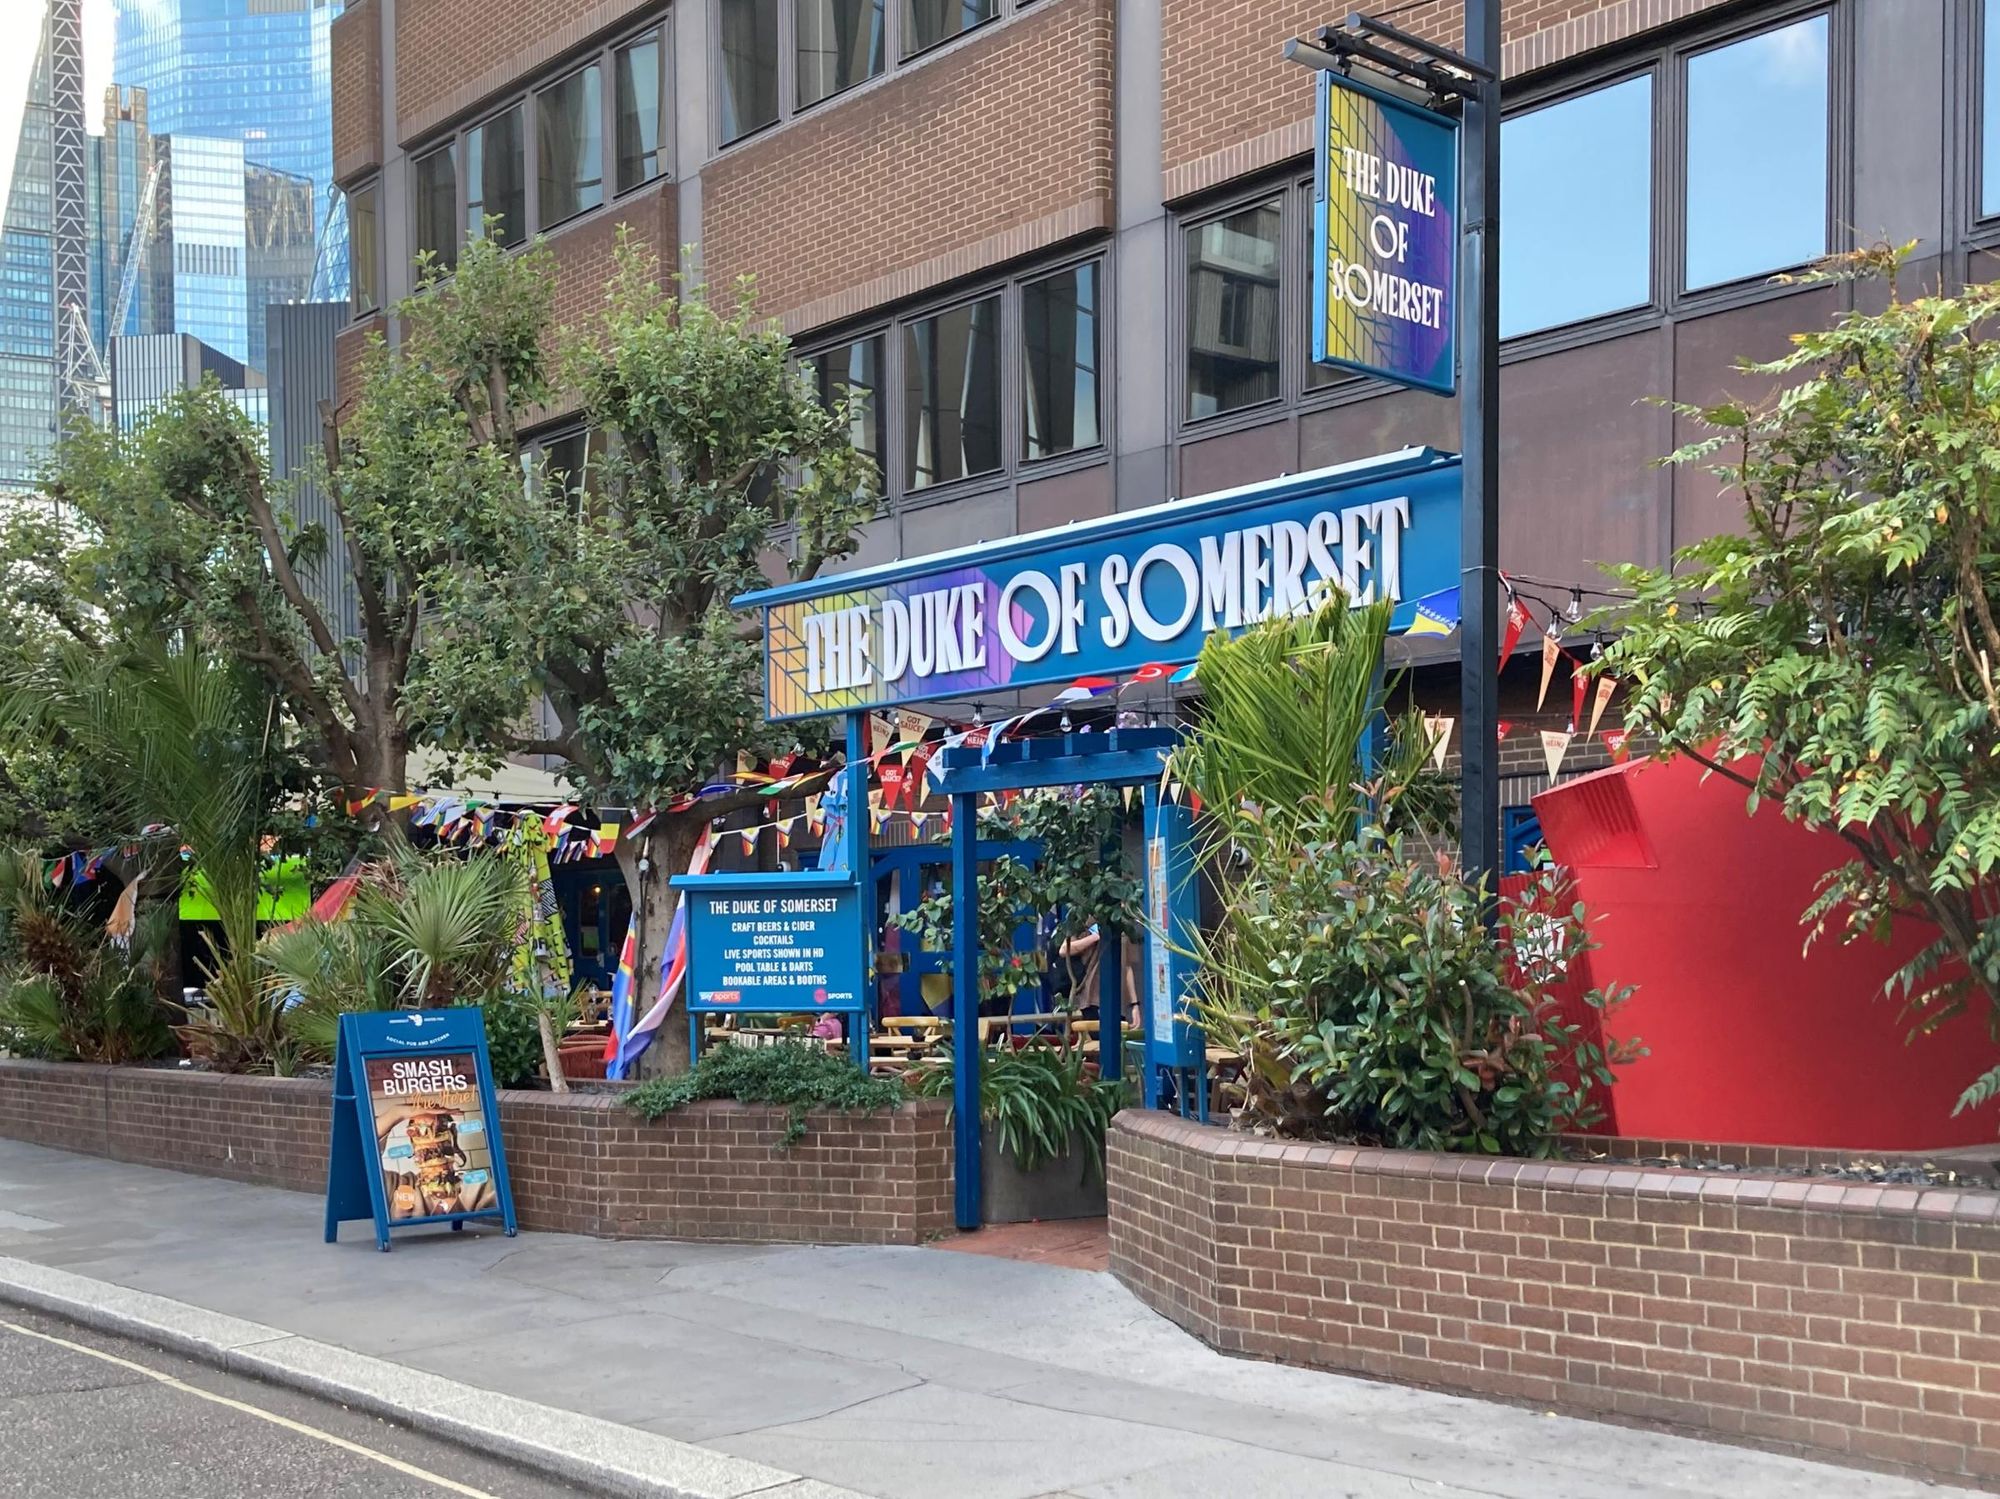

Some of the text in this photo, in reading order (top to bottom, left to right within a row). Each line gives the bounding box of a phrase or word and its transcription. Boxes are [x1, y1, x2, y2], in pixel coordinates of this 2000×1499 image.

[1343, 146, 1436, 218] THE DUKE
[1370, 214, 1409, 263] OF
[1332, 258, 1443, 329] SOMERSET
[802, 496, 1410, 694] THE DUKE OF SOMERSET
[907, 715, 921, 725] GOT
[873, 725, 890, 737] HEINZ
[900, 721, 924, 734] SAUCE?
[967, 736, 986, 746] HEIN
[881, 775, 902, 783] SAUCE?
[885, 769, 897, 777] GOT
[710, 898, 837, 915] THE DUKE OF SOMERSET
[732, 921, 815, 932] CRAFT BEERS & CIDER
[753, 935, 794, 945] COCKTAILS
[724, 948, 824, 960] LIVE SPORTS SHOWN IN HD
[735, 961, 813, 972] POOL TABLE & DARTS
[722, 975, 827, 986] BOOKABLE AREAS & BOOTHS
[827, 992, 853, 1000] SPORTS
[386, 1036, 405, 1046] SOCIAL
[429, 1032, 450, 1044] KITCHEN
[393, 1059, 453, 1079] SMASH
[383, 1074, 467, 1096] BURGERS
